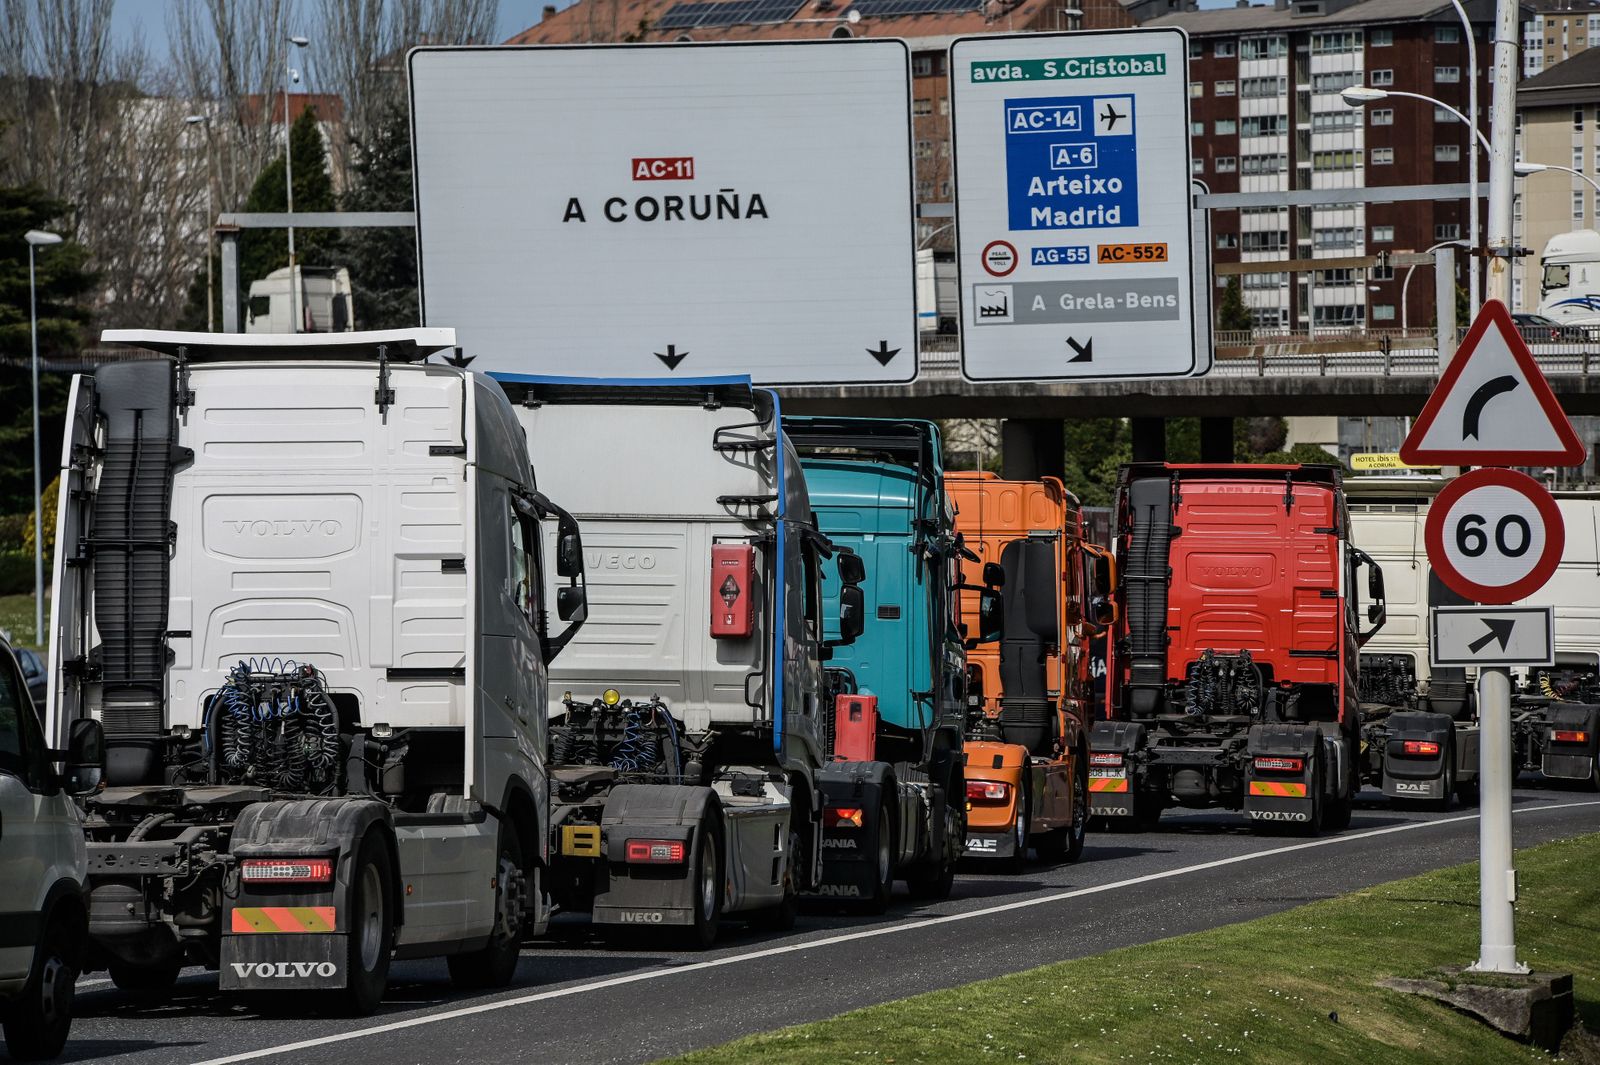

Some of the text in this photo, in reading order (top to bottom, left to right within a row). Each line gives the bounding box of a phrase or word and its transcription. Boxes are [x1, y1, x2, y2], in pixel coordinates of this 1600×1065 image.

[973, 56, 1164, 80] avda. S.Cristobal
[1013, 110, 1077, 129] AC-14
[1055, 147, 1093, 165] A-6
[635, 160, 693, 178] AC-11
[1027, 174, 1123, 196] Arteixo
[562, 188, 769, 223] A CORUÑA
[1031, 205, 1121, 227] Madrid
[1034, 246, 1165, 263] AG-55 AC-552
[1031, 292, 1177, 311] A Grela-Bens
[222, 519, 343, 537] VOLVO
[1456, 513, 1532, 558] 60
[586, 552, 656, 570] VECO
[1396, 783, 1431, 791] DAF
[1090, 807, 1128, 816] LVO
[1249, 810, 1307, 822] VOLVO
[821, 839, 857, 848] ANIA
[965, 839, 997, 848] AF
[620, 911, 663, 923] IVECO
[230, 962, 337, 978] VOLVO
